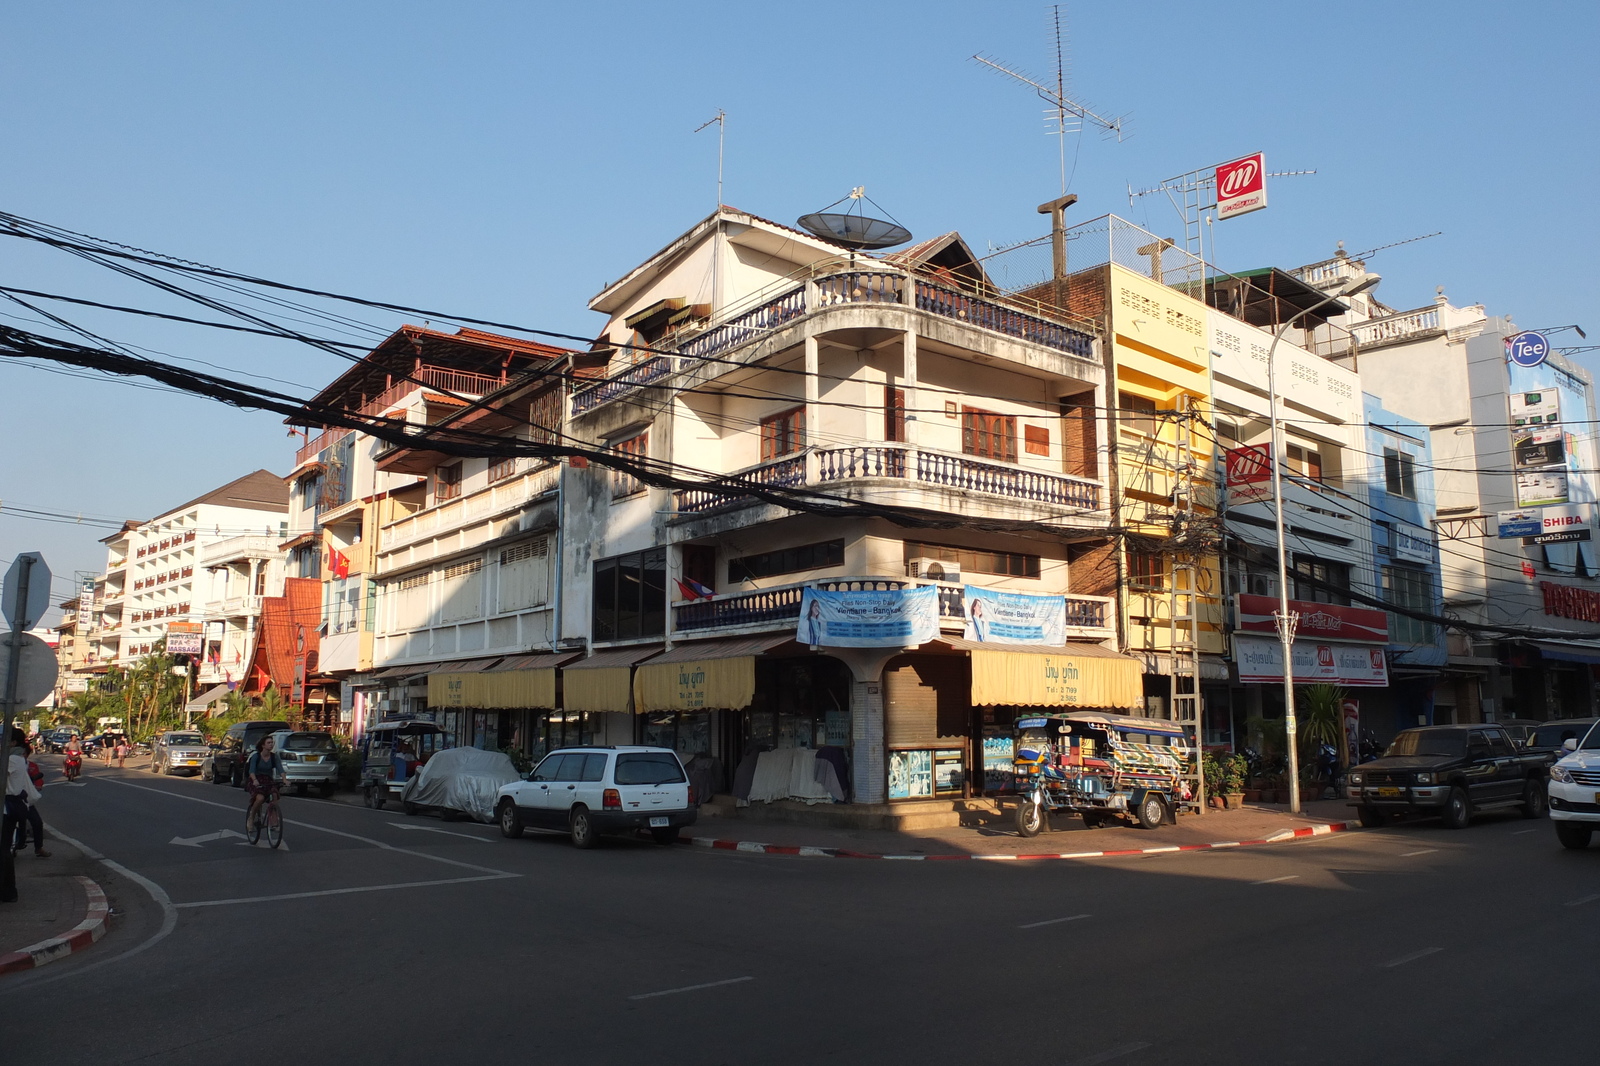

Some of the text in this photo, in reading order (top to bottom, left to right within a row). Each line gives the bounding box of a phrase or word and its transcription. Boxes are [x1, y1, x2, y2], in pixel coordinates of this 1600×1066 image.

[1515, 341, 1543, 358] Tee
[1544, 516, 1583, 528] SHIBA
[872, 606, 902, 616] Bangkok
